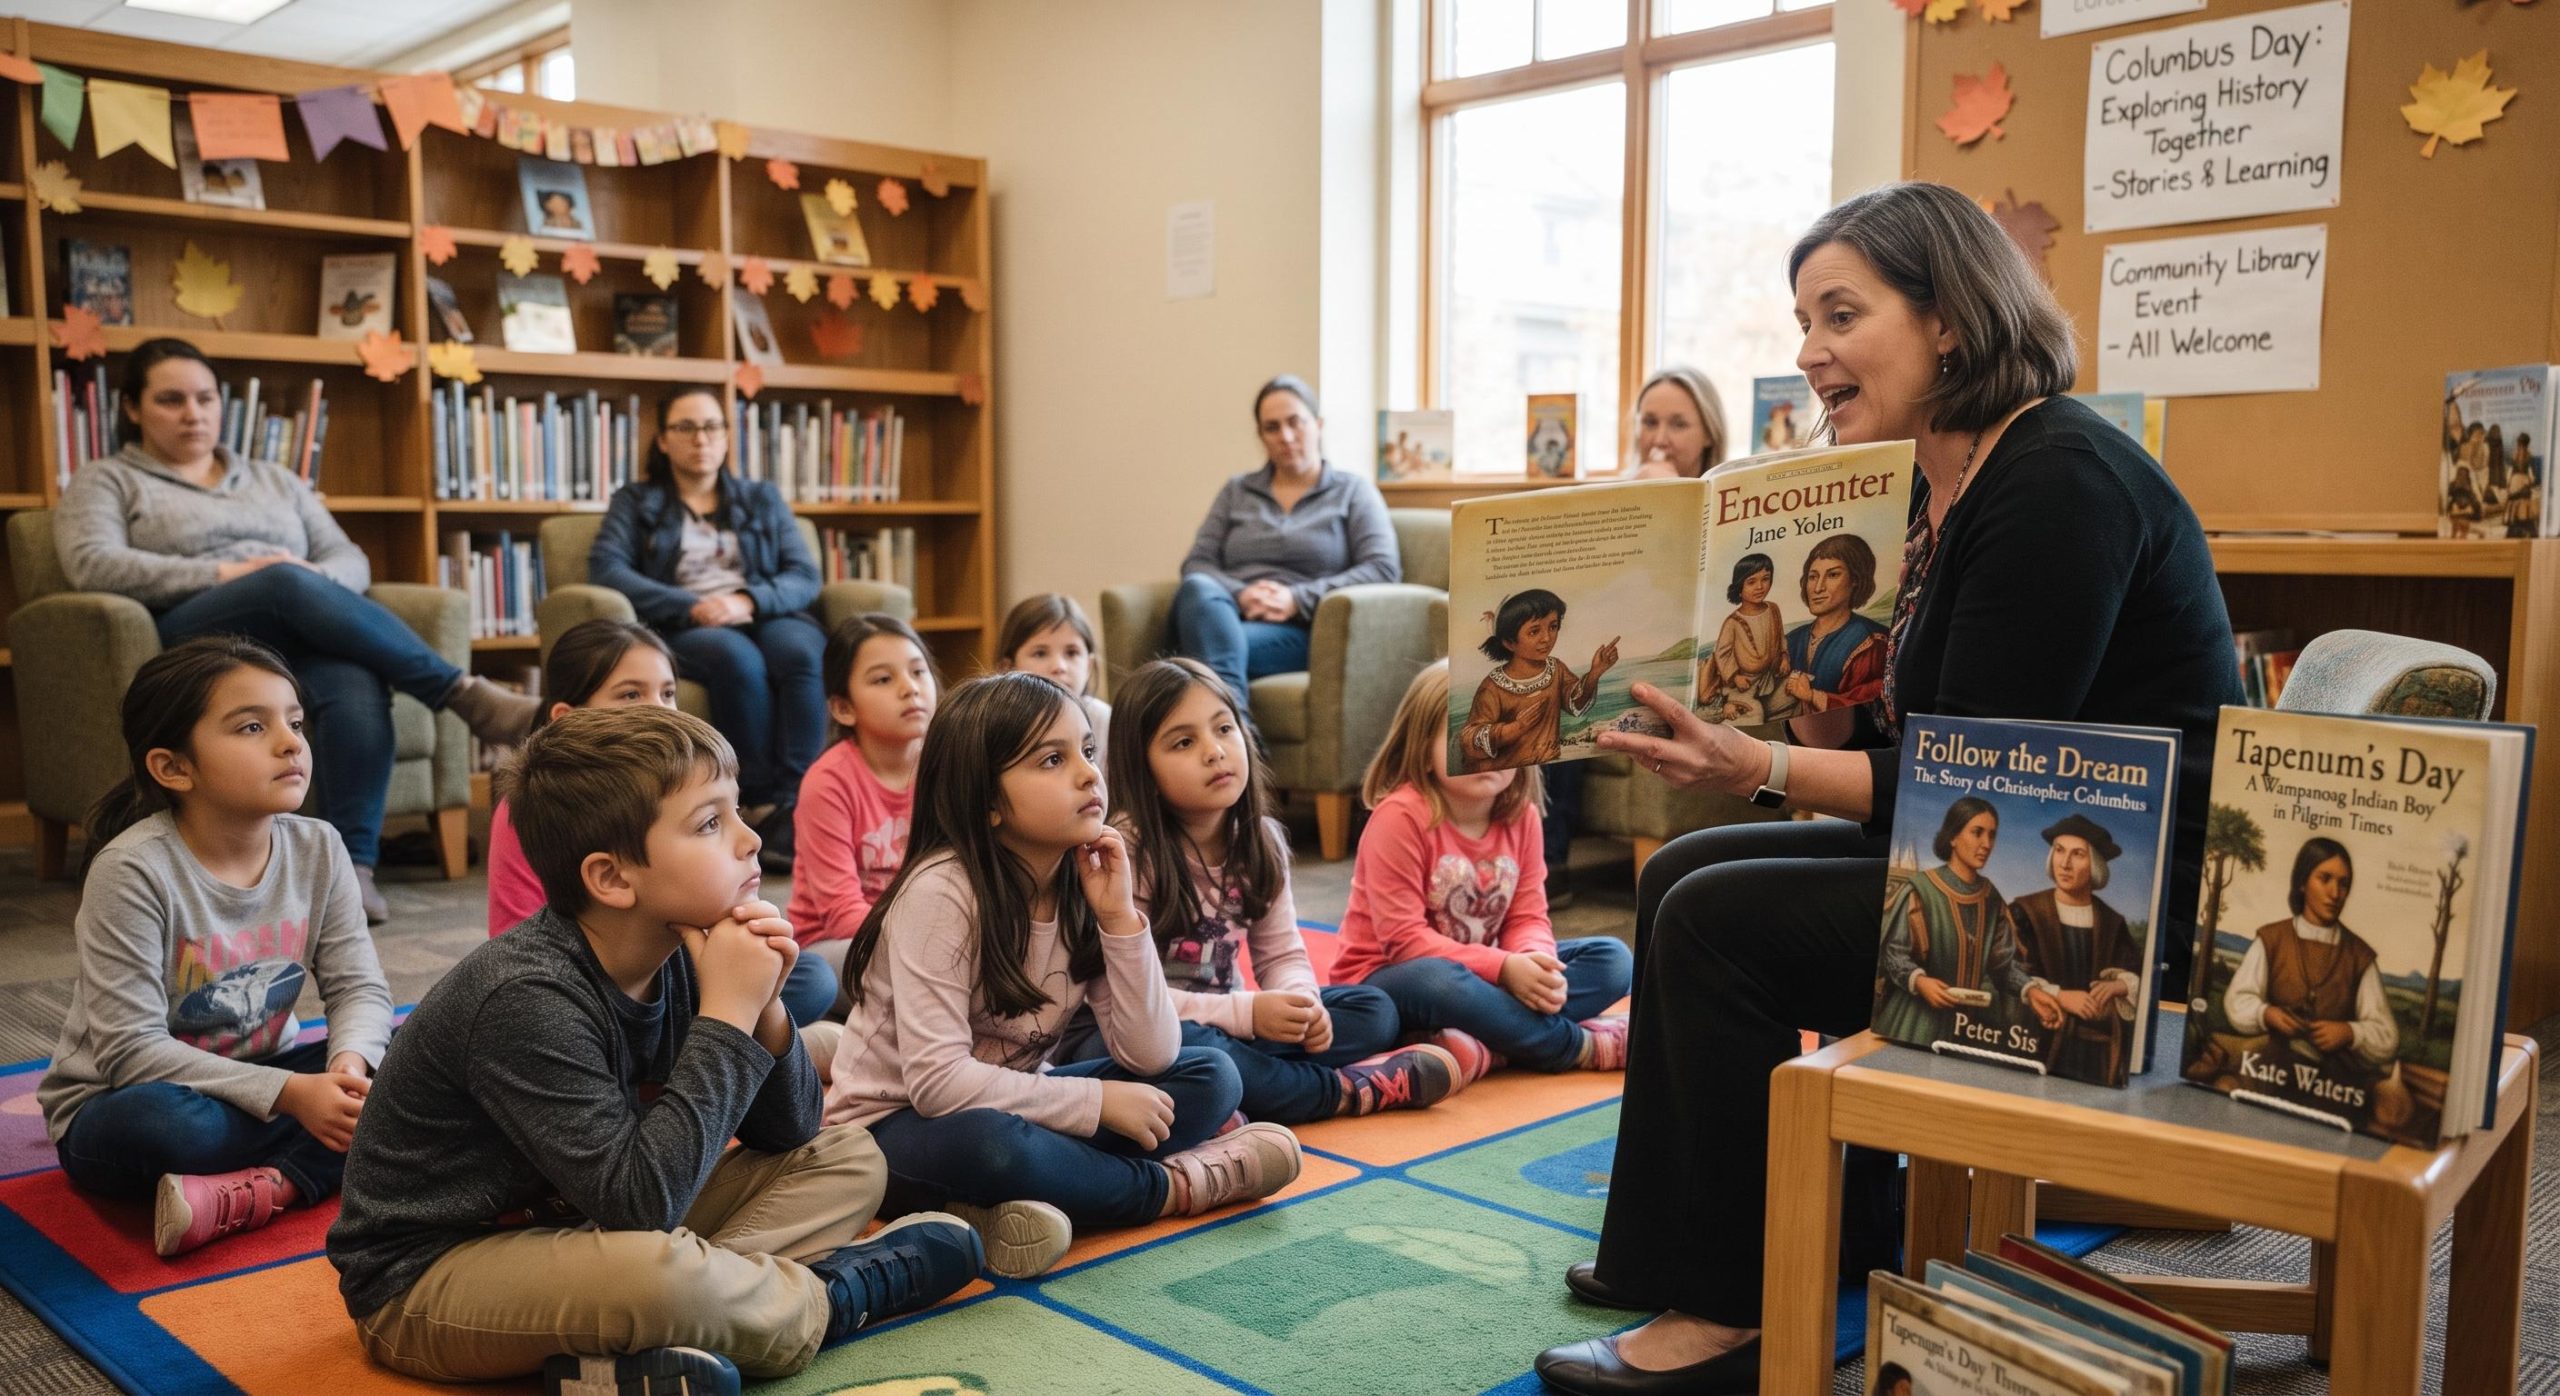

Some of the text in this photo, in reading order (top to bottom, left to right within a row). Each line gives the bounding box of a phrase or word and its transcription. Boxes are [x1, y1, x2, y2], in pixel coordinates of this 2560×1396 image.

[2105, 25, 2322, 84] Columbus Day:
[2101, 74, 2309, 130] Exploring History
[2144, 120, 2252, 163] Together
[2110, 169, 2193, 199] Stories
[2201, 159, 2214, 187] &
[2225, 152, 2329, 189] Learning
[2110, 246, 2320, 287] Community Library
[2135, 287, 2203, 318] Event
[2127, 328, 2159, 360] All
[2171, 326, 2273, 357] Welcome
[1716, 472, 1895, 527] Encounter
[1745, 512, 1845, 550] Jane Yolen
[1915, 729, 2148, 787] Follow the Dream
[2232, 728, 2464, 804] Tapenum's Day
[1914, 766, 2147, 812] The Story of Christopher Columbus
[2245, 775, 2435, 822] A Wampanoag Indian Boy
[2273, 803, 2393, 836] in Pilgrim Times
[1954, 1012, 2037, 1053] Peter Sis
[2239, 1050, 2365, 1107] Kate Waters
[1958, 1346, 1987, 1380] Day
